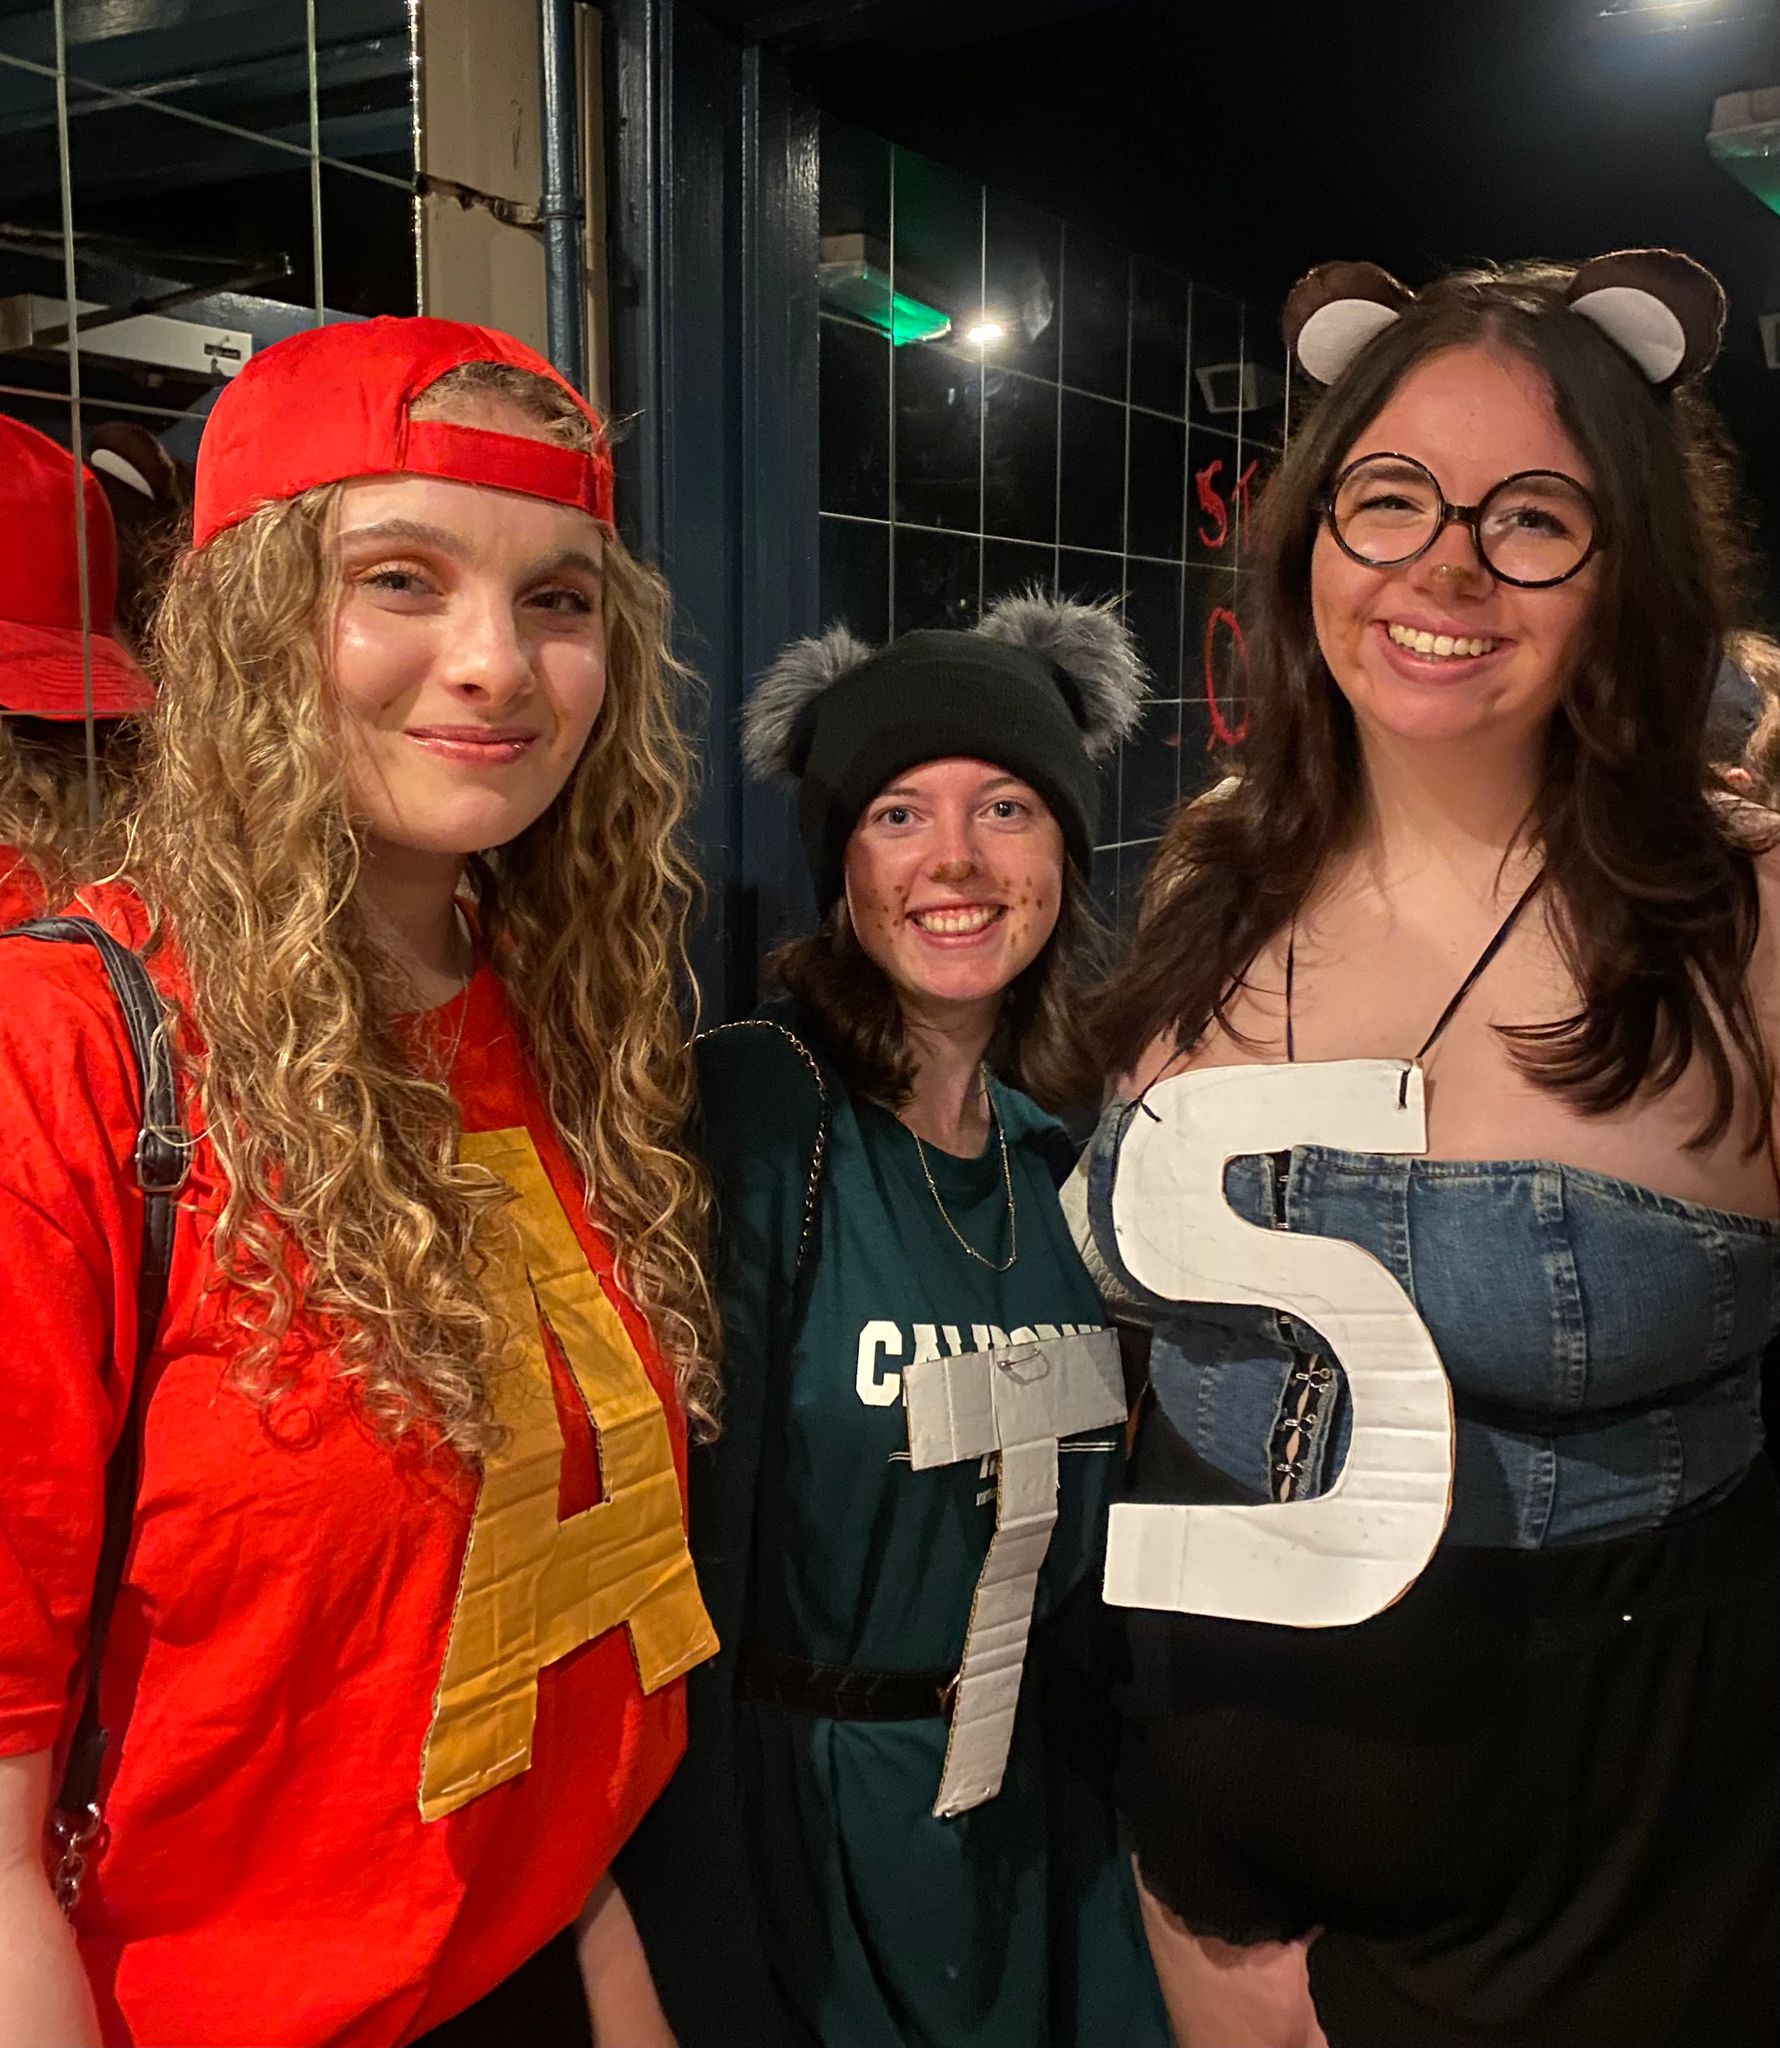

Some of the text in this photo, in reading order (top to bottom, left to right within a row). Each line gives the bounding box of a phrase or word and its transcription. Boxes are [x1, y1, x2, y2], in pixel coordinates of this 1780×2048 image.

[418, 1127, 720, 1822] A
[902, 1328, 1127, 1818] T
[1102, 1059, 1455, 1628] S
